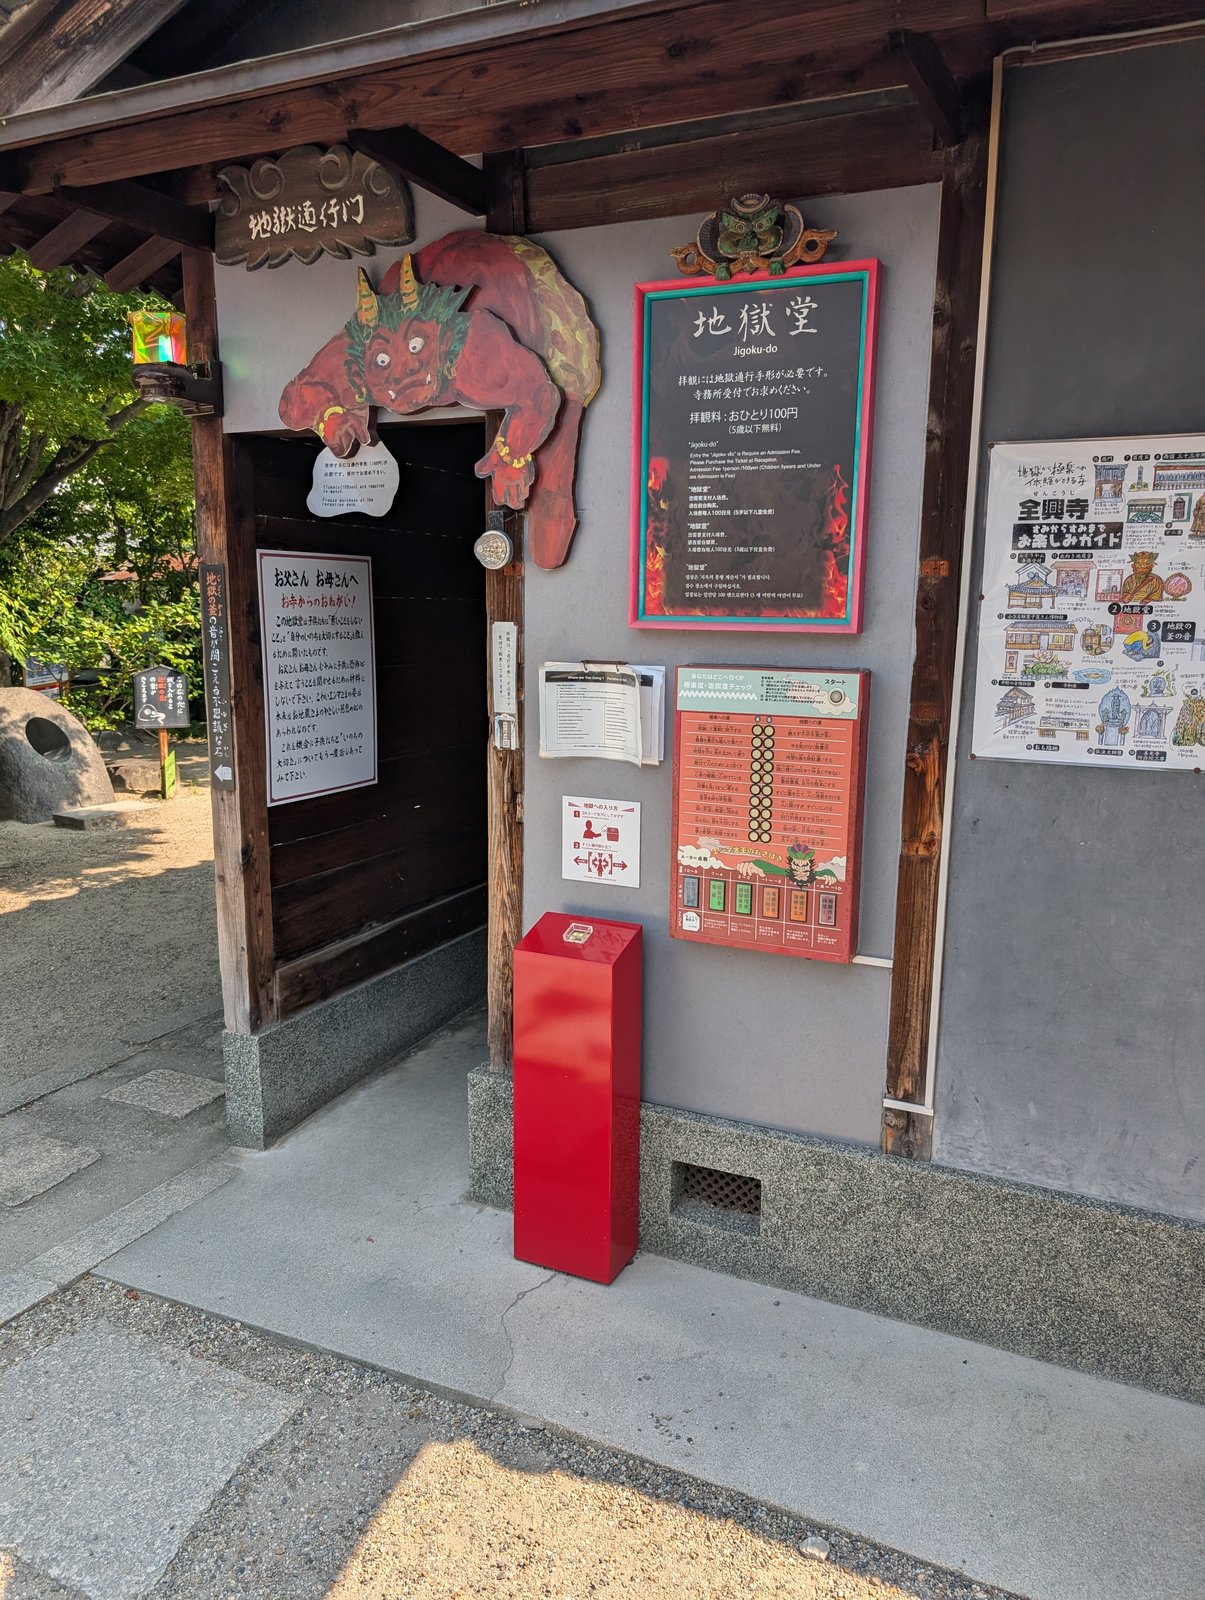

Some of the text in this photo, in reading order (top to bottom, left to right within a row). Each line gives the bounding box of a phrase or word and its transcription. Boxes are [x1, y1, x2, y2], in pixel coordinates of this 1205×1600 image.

[693, 296, 818, 342] 地獄堂
[733, 344, 778, 357] Jigoku-do
[678, 366, 829, 387] 拝観には地獄通行手形が必要です。
[693, 384, 811, 401] 寺務所受付でお求めください。
[1018, 498, 1089, 521] 全興寺
[1032, 524, 1106, 535] すみからすみまで
[1017, 533, 1121, 549] お楽しみガイド
[274, 568, 359, 588] お父さん お母さんへ
[1123, 606, 1151, 614] 地獄堂
[1166, 622, 1192, 631] 地獄の
[1167, 632, 1192, 641] 釜の音
